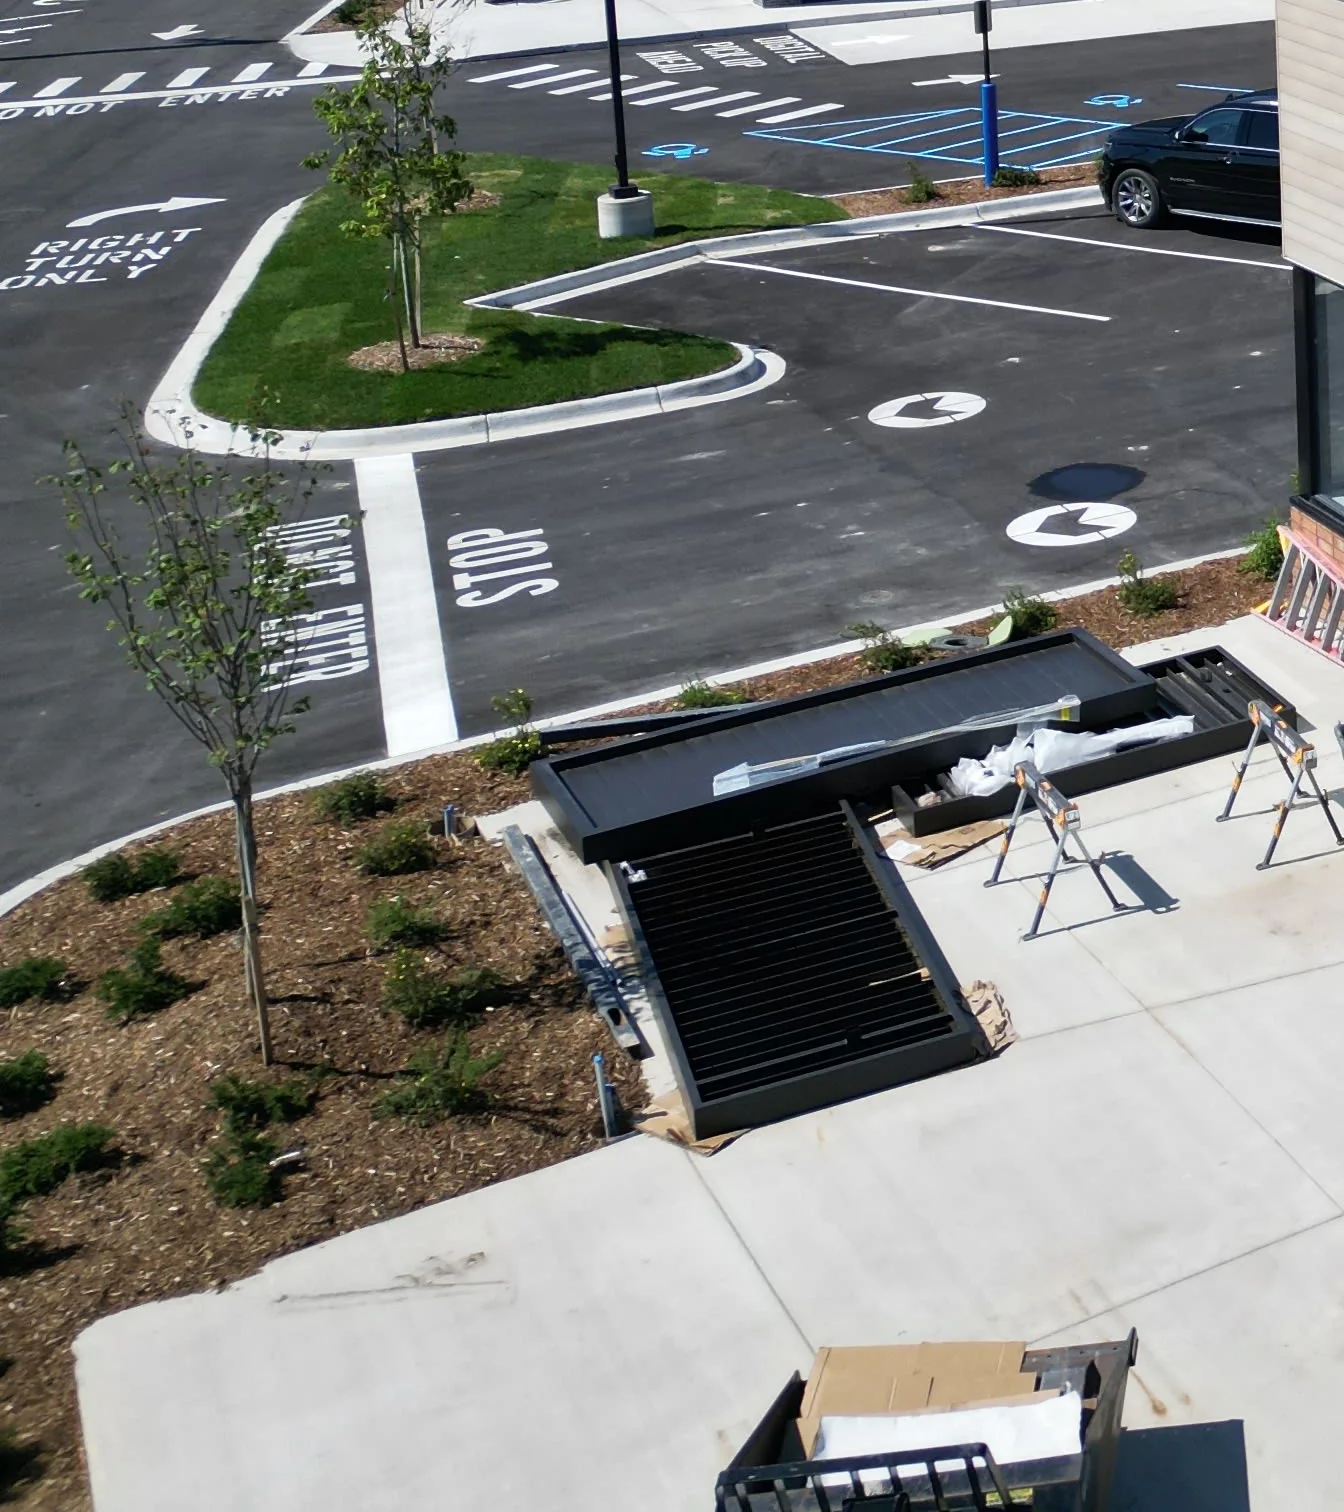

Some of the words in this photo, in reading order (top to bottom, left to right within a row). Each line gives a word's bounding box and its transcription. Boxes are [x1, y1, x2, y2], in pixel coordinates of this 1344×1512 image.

[33, 100, 125, 117] NOT
[158, 87, 291, 107] ENTER
[31, 228, 202, 255] RIGHT
[25, 246, 172, 271] TURN
[0, 263, 158, 289] ONLY
[447, 528, 559, 608] STOP
